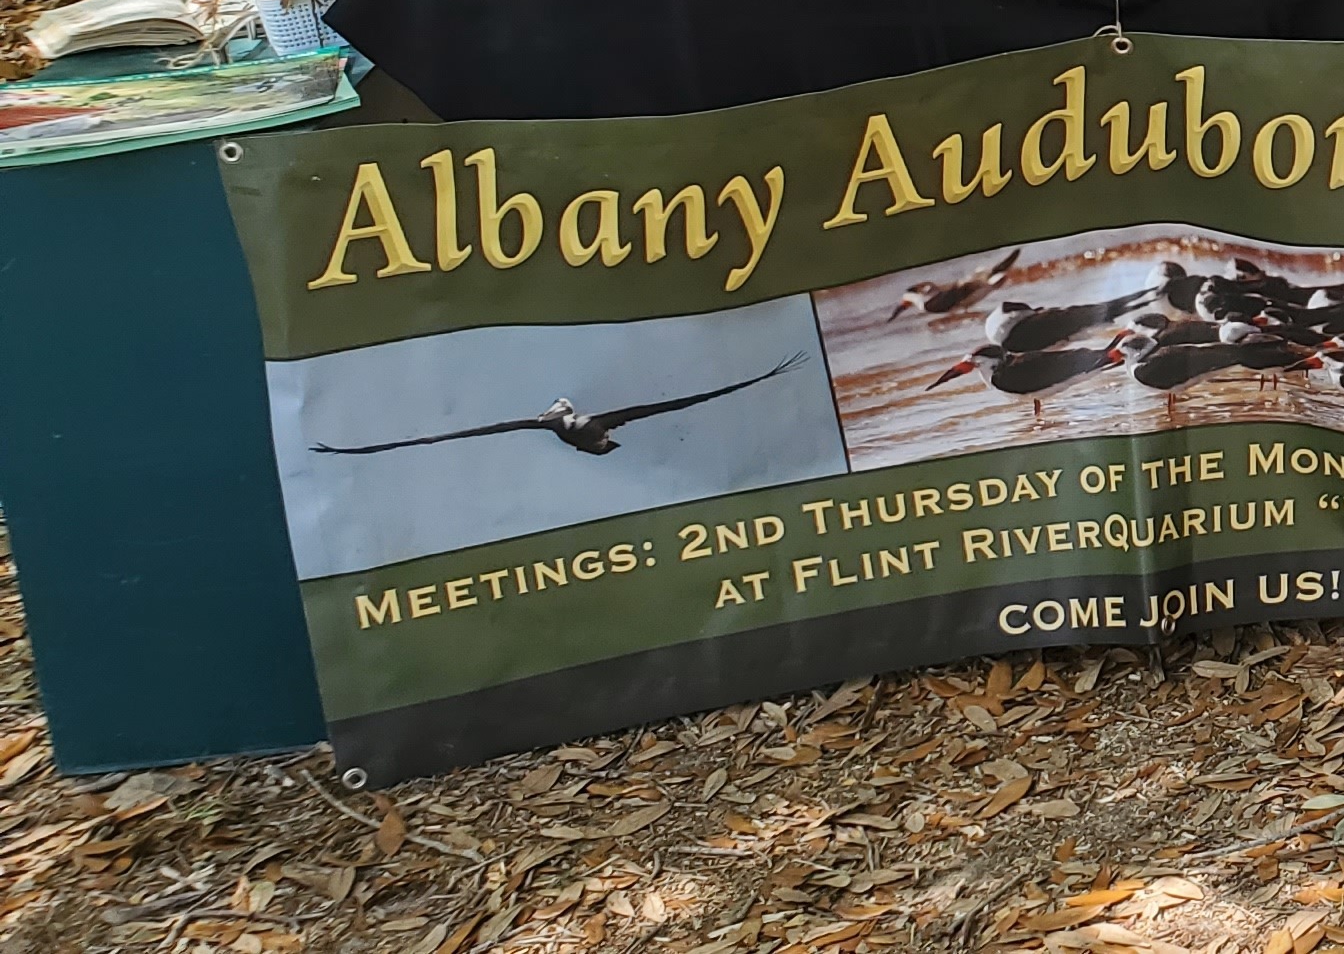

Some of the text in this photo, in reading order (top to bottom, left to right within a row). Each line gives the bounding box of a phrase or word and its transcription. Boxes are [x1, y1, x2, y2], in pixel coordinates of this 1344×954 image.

[306, 146, 785, 292] Albany
[355, 539, 656, 630] MEETINGS:
[680, 513, 786, 562] 2ND
[802, 468, 1063, 536] THURSDAY
[1079, 464, 1126, 495] OF
[1140, 451, 1225, 489] THE
[714, 571, 771, 609] AT
[795, 541, 940, 594] FLINT
[962, 496, 1296, 564] RIVERQUARIUM
[999, 570, 1341, 635] COME JOIN US!
